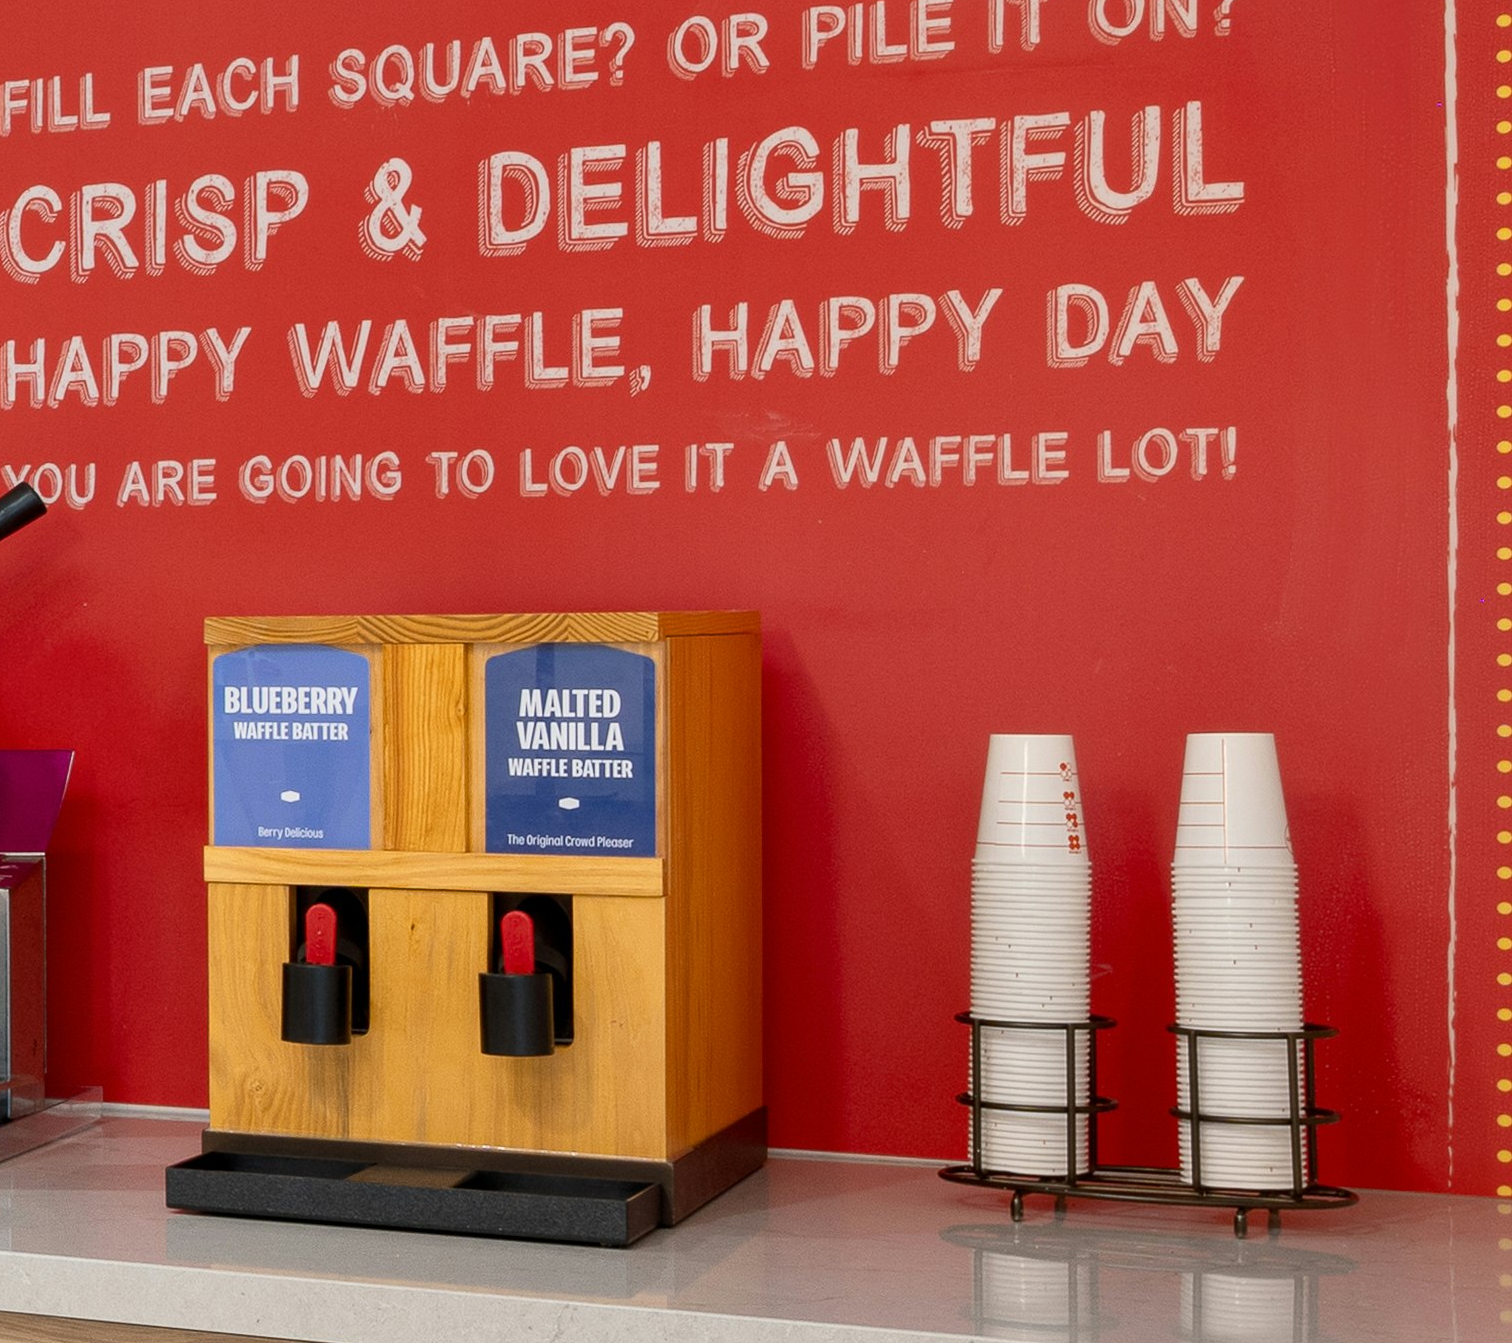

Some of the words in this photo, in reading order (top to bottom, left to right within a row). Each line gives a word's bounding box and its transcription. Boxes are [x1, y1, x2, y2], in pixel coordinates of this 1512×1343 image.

[0, 72, 111, 136] FILL
[137, 55, 301, 126] EACH
[328, 22, 637, 110] SQUARE?
[666, 12, 768, 80] OR
[358, 157, 427, 262] &
[477, 100, 1245, 256] DELIGHTFUL
[0, 326, 251, 411] HAPPY
[289, 306, 653, 399] WAFFLE,
[692, 288, 1004, 382] HAPPY
[1044, 276, 1245, 370] DAY
[0, 462, 96, 511] YOU
[117, 457, 216, 508] ARE
[240, 451, 401, 503] GOING
[431, 450, 494, 496] TO
[517, 444, 660, 496] LOVE
[685, 441, 733, 492] IT
[758, 442, 797, 491] A
[826, 431, 1070, 488] WAFFLE
[1097, 427, 1238, 482] LOT!
[223, 686, 358, 715] BLUEBERRY
[518, 688, 622, 718] MALTED
[233, 721, 289, 741] WAFFLE
[292, 721, 349, 742] BATTER
[516, 721, 625, 751] VANILLA
[507, 757, 569, 778] WAFFLE
[571, 758, 633, 779] BATTER
[258, 825, 282, 841] Berry
[284, 826, 324, 840] Delicious
[507, 833, 524, 847] The
[526, 834, 564, 849] Original
[565, 834, 594, 848] Crowd
[596, 836, 634, 849] Pleaser
